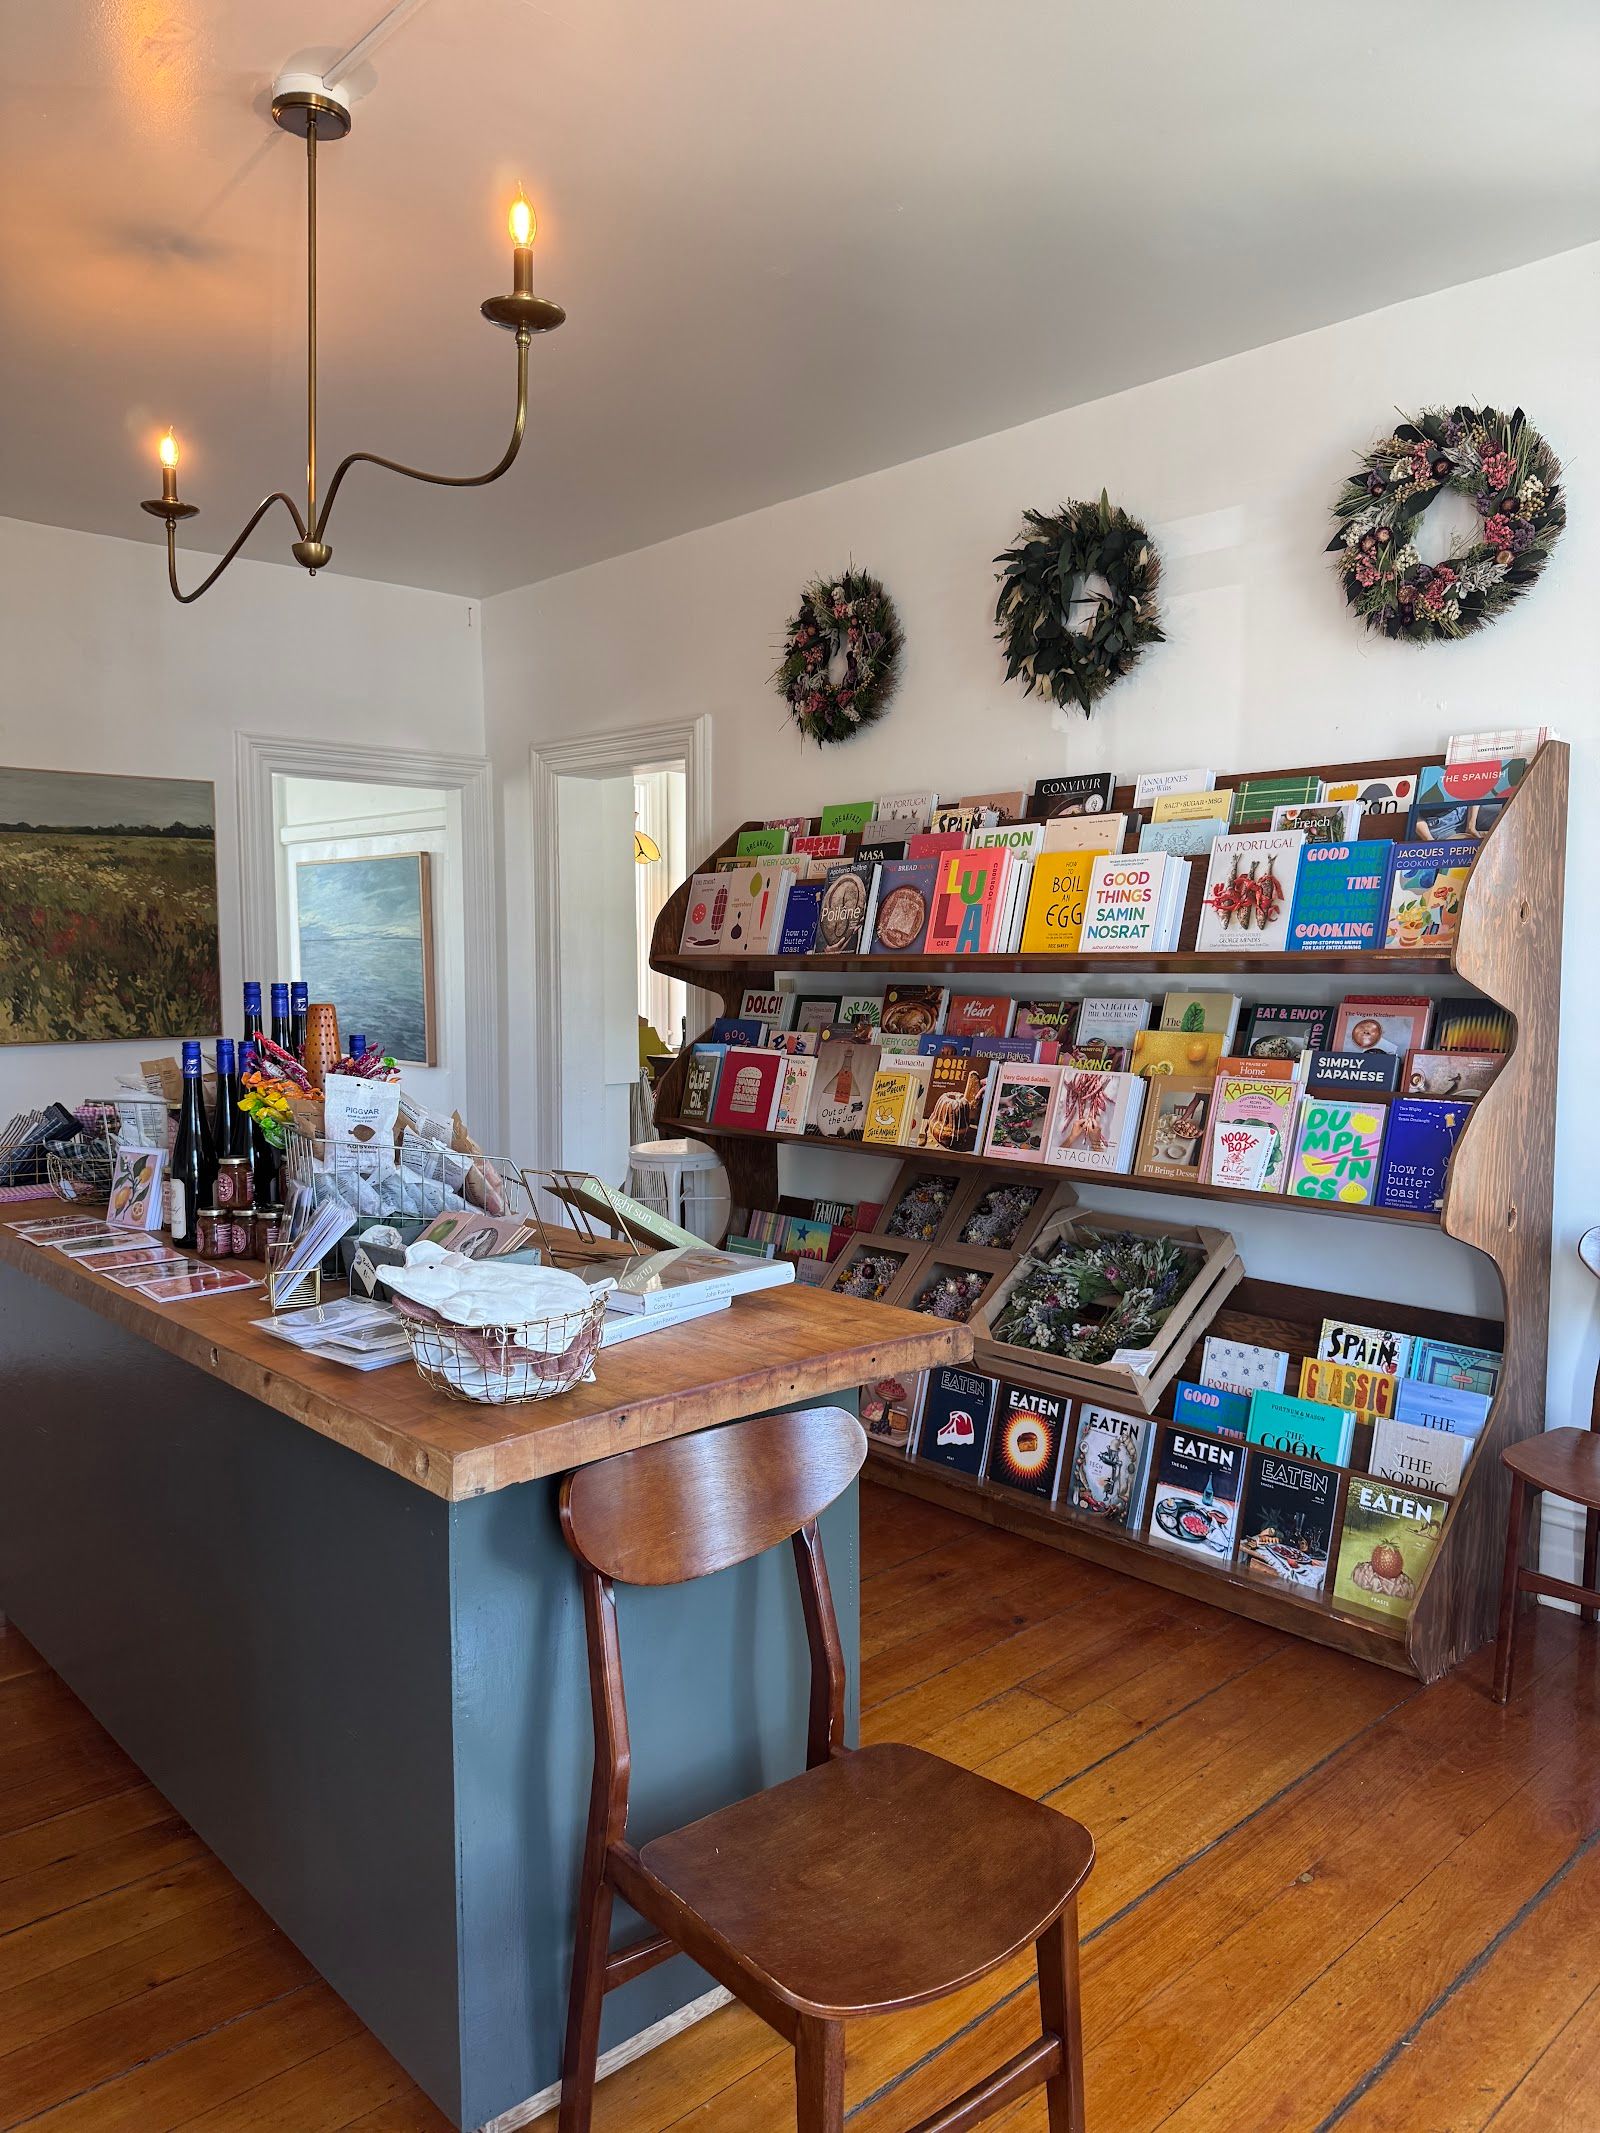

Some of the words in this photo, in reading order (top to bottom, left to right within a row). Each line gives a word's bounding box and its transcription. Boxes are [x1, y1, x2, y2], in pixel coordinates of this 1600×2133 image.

[1440, 773, 1459, 784] THE
[1461, 770, 1506, 782] SPANISH
[1042, 777, 1101, 794] CONVIVIR
[1294, 816, 1331, 829] French
[795, 836, 840, 853] PASTA
[976, 831, 1034, 850] LEMON
[1217, 841, 1233, 853] MY
[1236, 838, 1295, 852] PORTUGAL
[858, 850, 885, 862] MASA
[1307, 847, 1349, 862] GOOD
[1397, 847, 1444, 861] JACQUES
[762, 857, 780, 867] VERY
[779, 857, 801, 867] GOOD
[897, 864, 918, 872] BREAD
[1396, 858, 1438, 870] COOKING
[1442, 857, 1456, 867] MY
[1458, 857, 1475, 867] WA
[1052, 875, 1084, 893] BOIL
[1103, 871, 1150, 886] GOOD
[1346, 876, 1383, 890] TIME
[1061, 893, 1071, 903] AN
[1097, 888, 1152, 904] THINGS
[820, 906, 861, 923] Poilâne
[1046, 902, 1083, 928] EGG
[1096, 906, 1145, 921] SAMIN
[785, 929, 799, 937] how
[799, 929, 809, 937] to
[1087, 924, 1149, 939] NOSRAT
[1295, 922, 1374, 939] COOKING
[783, 937, 806, 945] butter
[782, 945, 800, 953] toast
[844, 1001, 860, 1022] FOR
[862, 1001, 880, 1028] DINNE
[963, 1001, 996, 1018] Heart
[1256, 1007, 1279, 1018] EAT
[1279, 1008, 1288, 1019] &
[1290, 1008, 1328, 1021] ENJOY
[1025, 1013, 1069, 1026] BAKING
[1165, 1017, 1181, 1027] The
[901, 1038, 919, 1047] GOO
[1311, 1023, 1324, 1051] GLUT
[976, 1049, 1006, 1060] Bodega
[1007, 1050, 1031, 1062] Bakes
[1318, 1056, 1365, 1069] SIMPLY
[936, 1057, 968, 1070] DOBRE
[1069, 1058, 1113, 1072] BAKING
[933, 1068, 966, 1080] DOBRE
[1240, 1067, 1267, 1076] Home
[1316, 1070, 1385, 1082] JAPANESE
[1224, 1082, 1293, 1102] KAPUSTA
[345, 1106, 380, 1115] PIGGVAR
[821, 1109, 836, 1118] Out
[838, 1106, 847, 1115] of
[829, 1117, 841, 1125] the
[1220, 1131, 1260, 1149] NOODLE
[1227, 1142, 1250, 1155] BOX
[1056, 1149, 1115, 1166] STAGIONI
[1154, 1166, 1175, 1178] Bring
[1176, 1169, 1199, 1178] Desse
[1389, 1162, 1417, 1174] how
[1422, 1166, 1435, 1176] to
[1387, 1174, 1431, 1188] butter
[1386, 1186, 1420, 1199] toast
[590, 1181, 634, 1212] midnight
[633, 1208, 652, 1224] sun
[813, 1202, 847, 1227] FAMILY
[941, 1371, 985, 1398] EATEN
[1207, 1378, 1253, 1397] PORTUG
[1306, 1362, 1390, 1415] CLASSIC
[1009, 1390, 1059, 1418] EATEN
[1183, 1388, 1220, 1408] GOOD
[1090, 1411, 1139, 1441] EATEN
[1421, 1412, 1457, 1433] THE
[1217, 1425, 1246, 1440] TIME
[1285, 1430, 1305, 1441] THE
[1173, 1435, 1234, 1468] EATEN
[1398, 1454, 1433, 1475] THE
[1262, 1459, 1328, 1494] EATEN
[1379, 1467, 1446, 1493] NORDIC
[1359, 1487, 1433, 1523] EATEN
